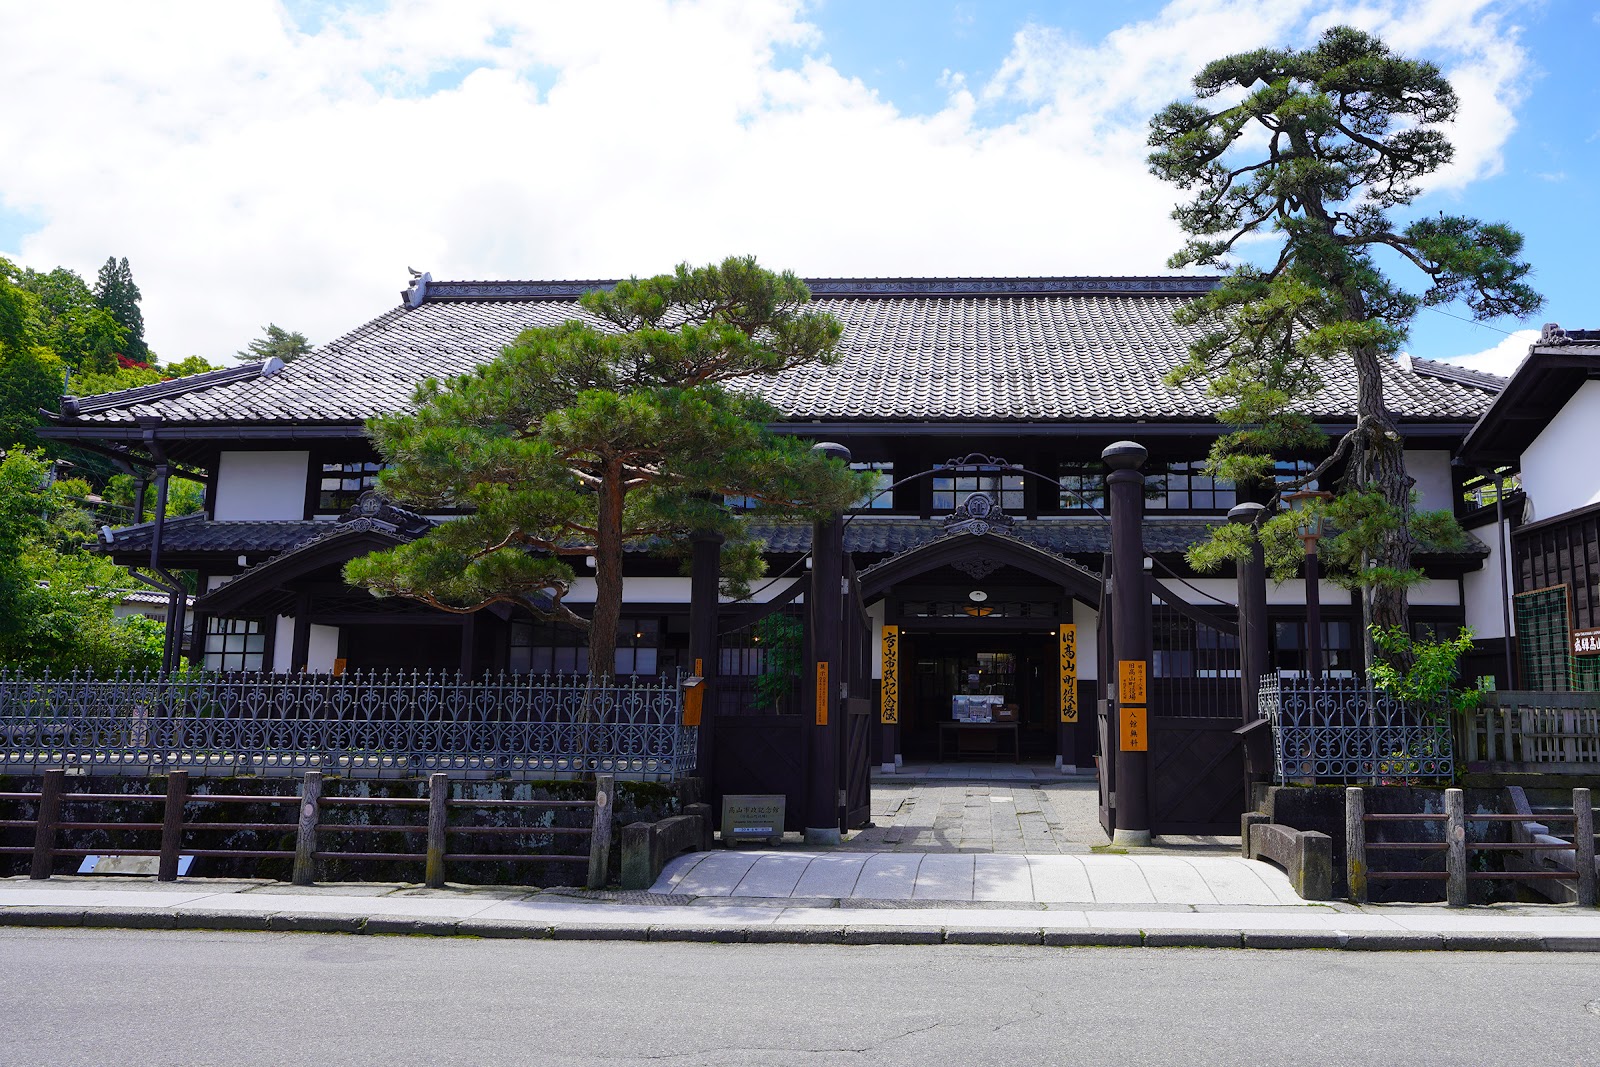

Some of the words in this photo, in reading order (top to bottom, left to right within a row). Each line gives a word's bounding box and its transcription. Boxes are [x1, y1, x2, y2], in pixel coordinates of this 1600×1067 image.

[1062, 630, 1077, 719] 旧高山町役場
